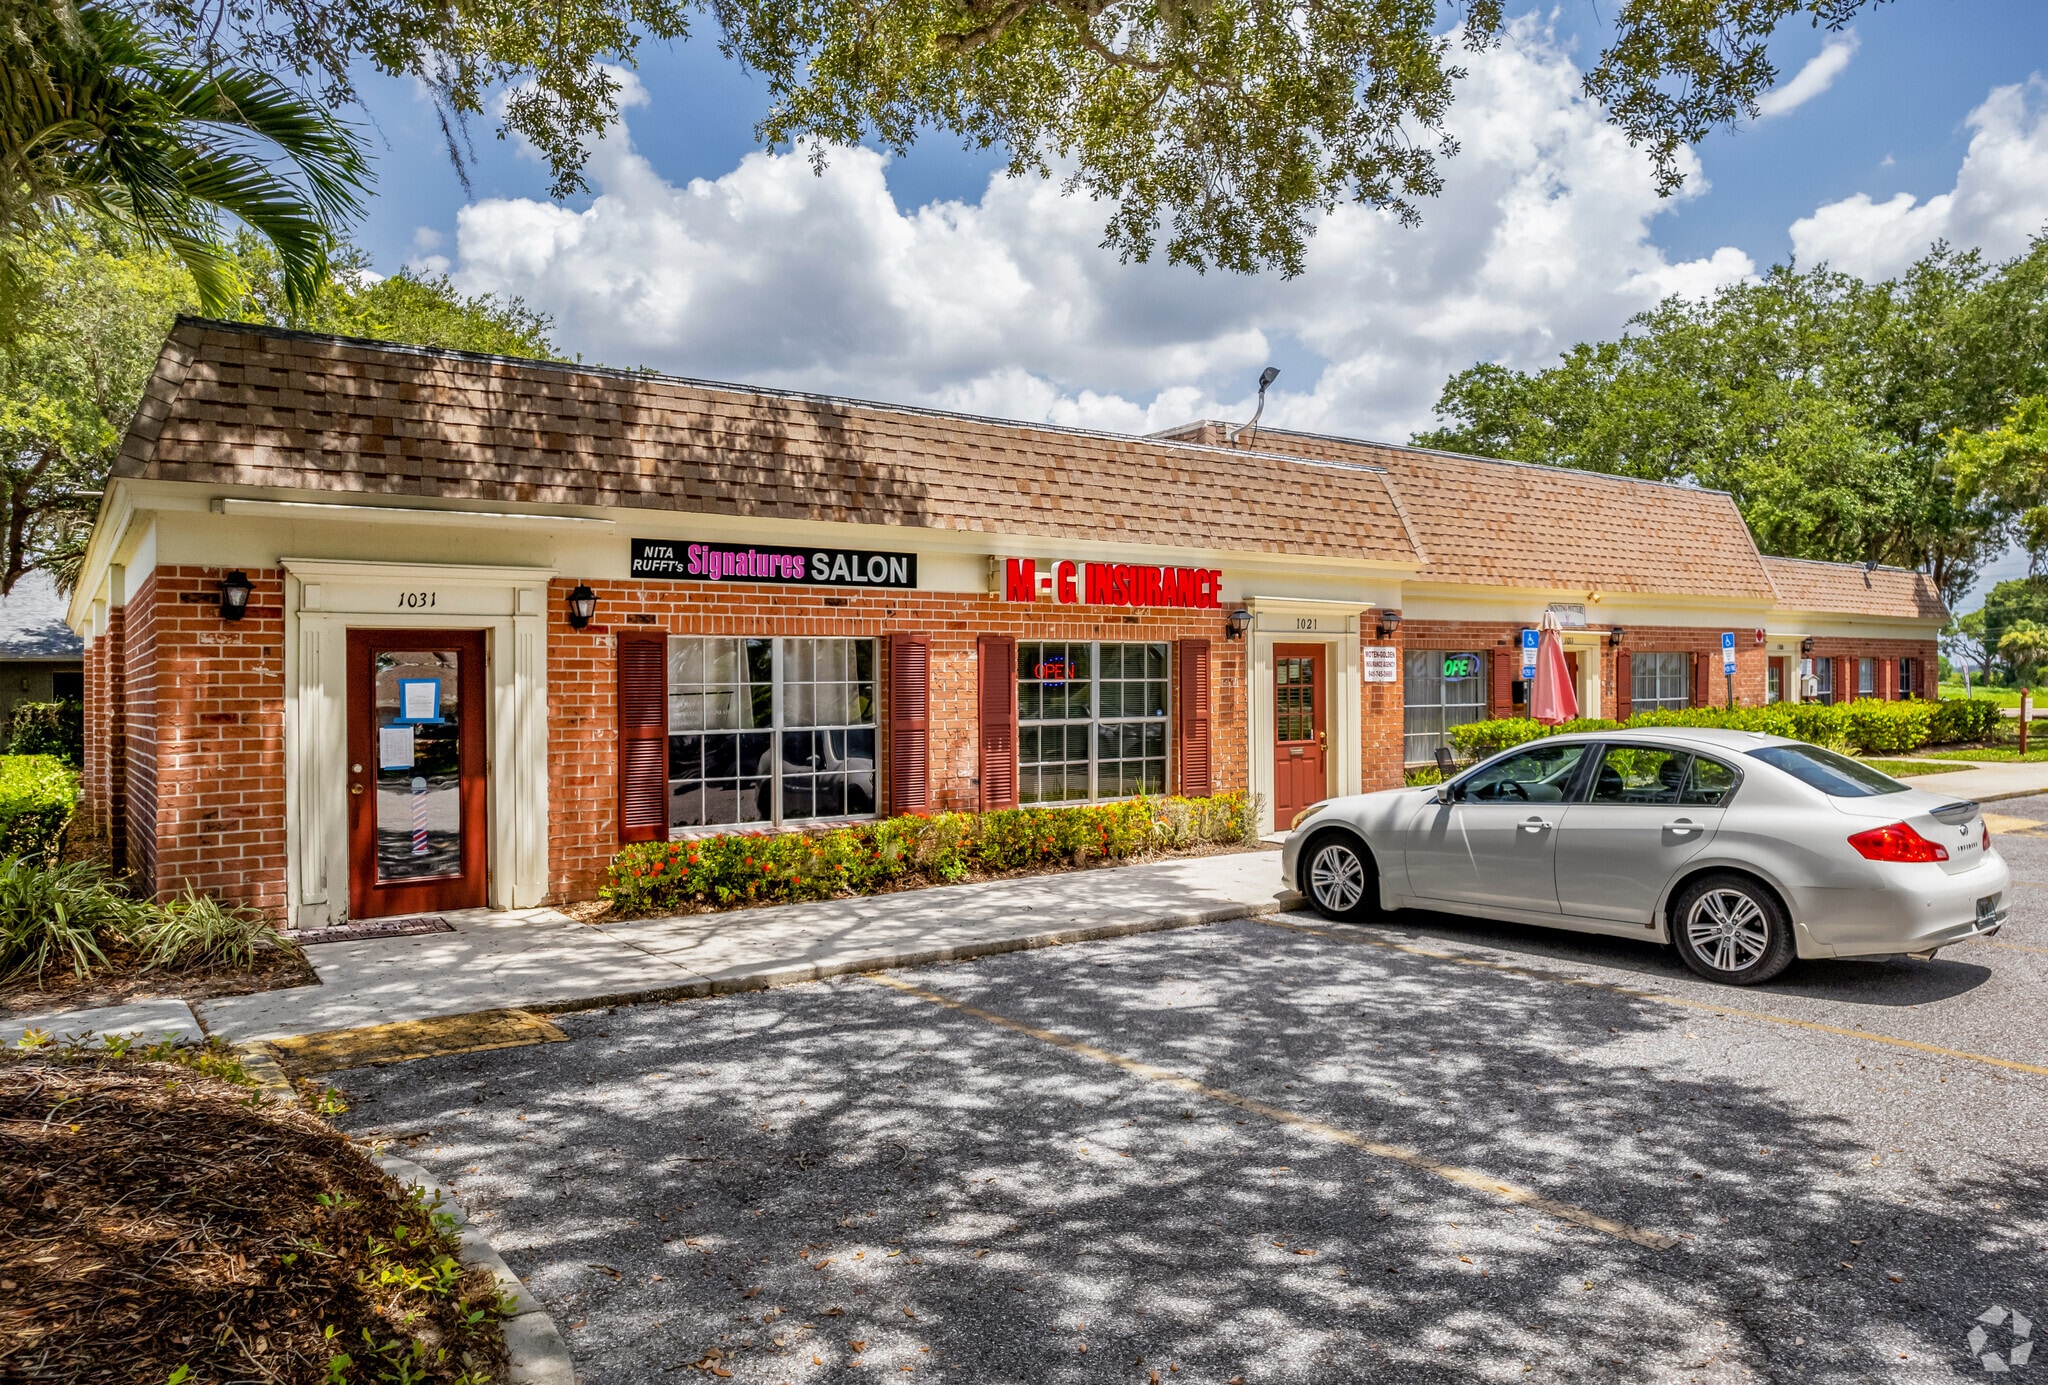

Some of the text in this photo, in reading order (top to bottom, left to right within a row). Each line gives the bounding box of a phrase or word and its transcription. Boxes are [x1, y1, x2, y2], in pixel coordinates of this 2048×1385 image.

[643, 545, 674, 559] NITA
[632, 559, 684, 572] RUFFT's
[687, 544, 908, 584] Signatures SALON
[1083, 561, 1223, 609] INSURANCE
[397, 591, 436, 608] 1031
[1296, 617, 1317, 630] 1021
[1033, 663, 1075, 680] OPEN
